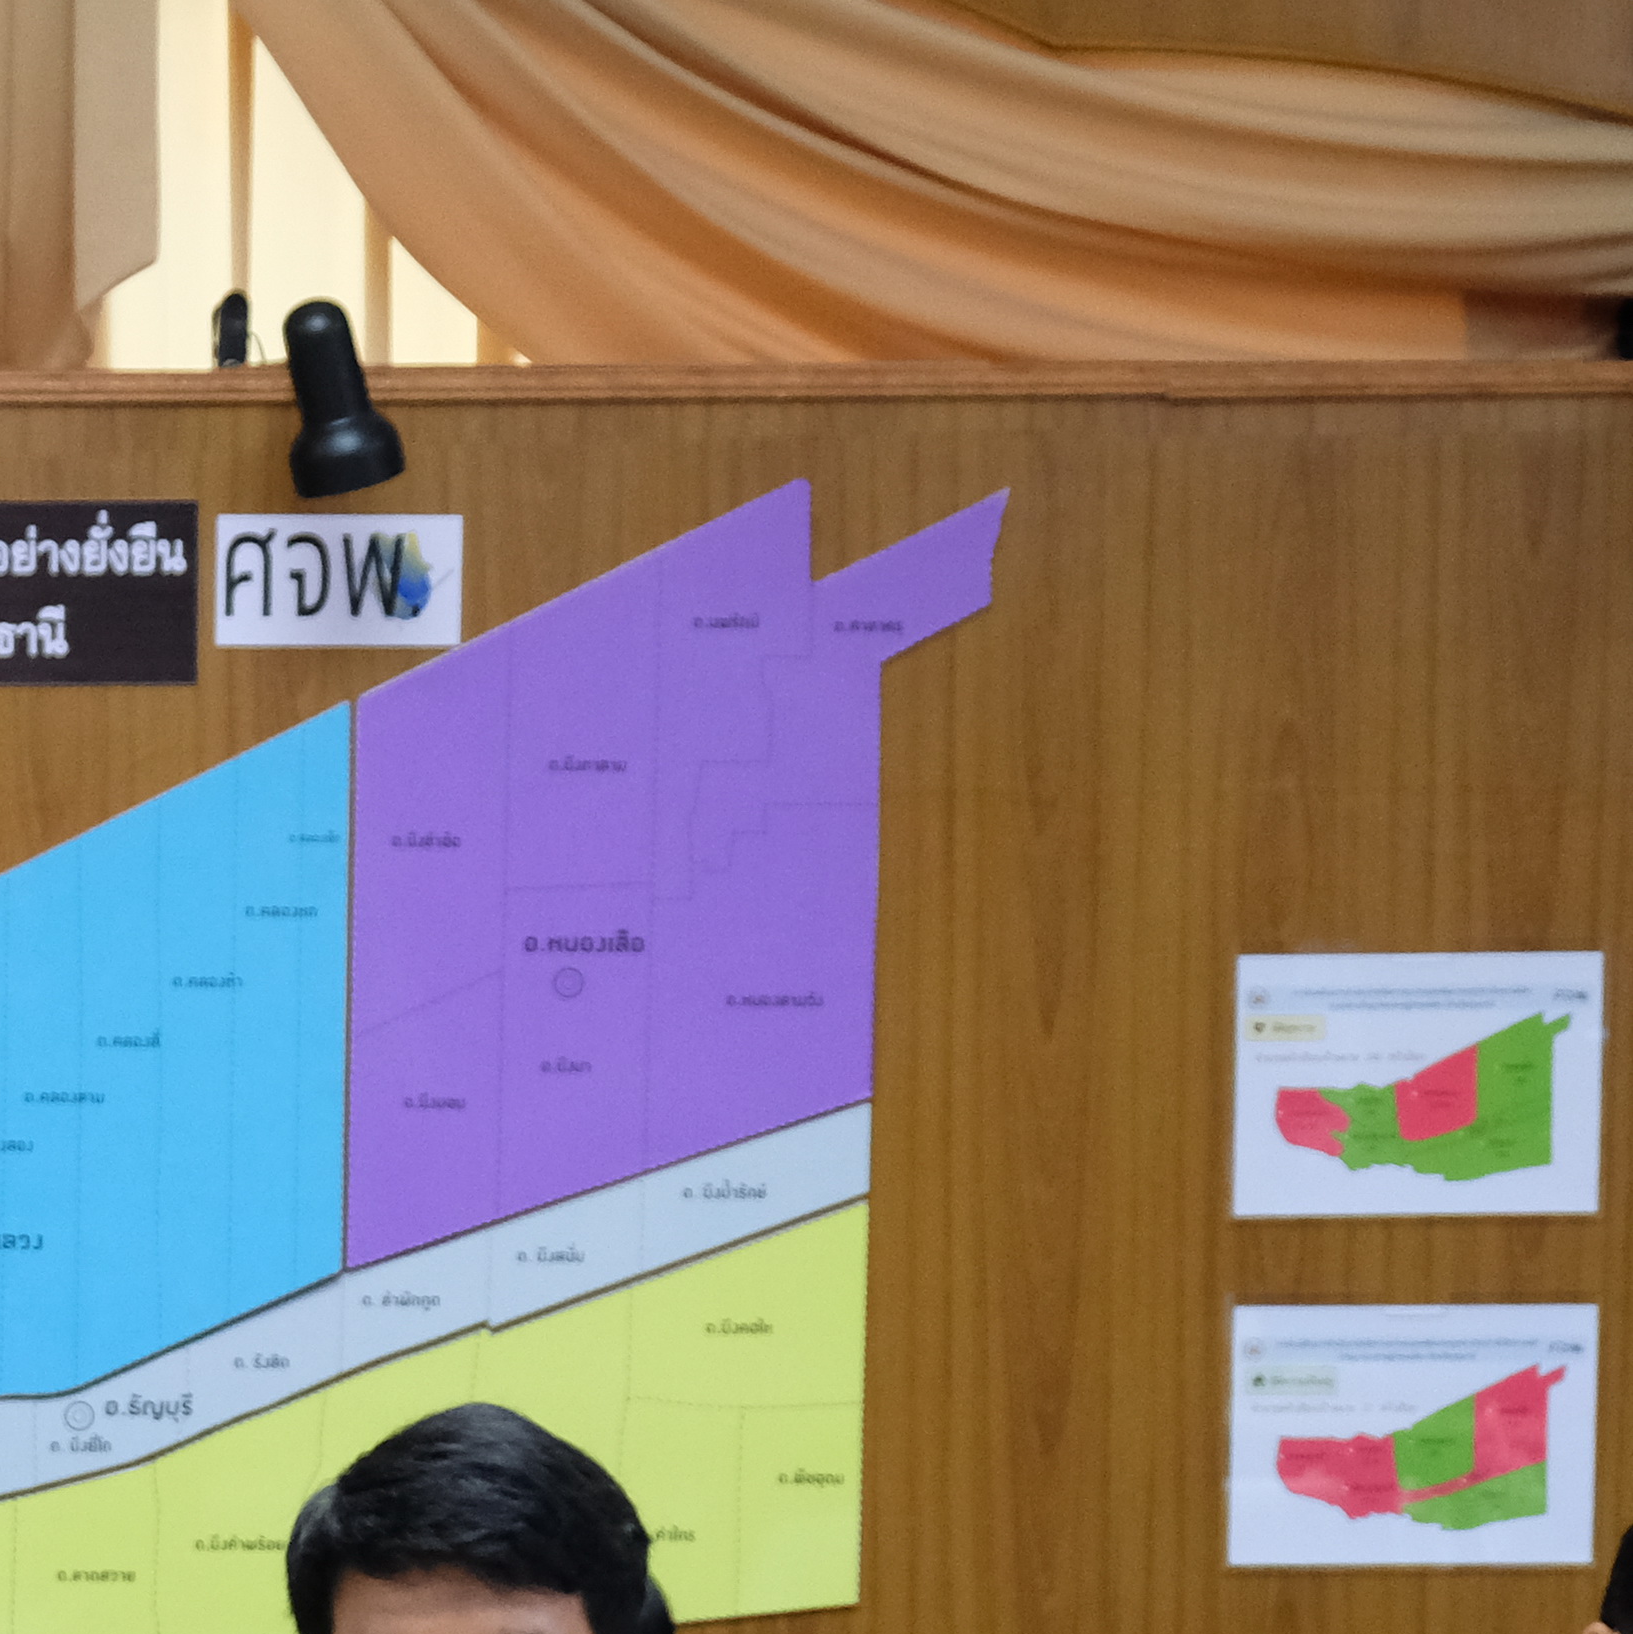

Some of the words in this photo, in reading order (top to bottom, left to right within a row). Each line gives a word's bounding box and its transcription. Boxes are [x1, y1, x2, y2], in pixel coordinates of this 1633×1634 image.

[224, 528, 406, 618] ศจพ
[523, 928, 646, 954] อ.หนองเสือ
[104, 1392, 193, 1423] อ.ธัญบุรี
